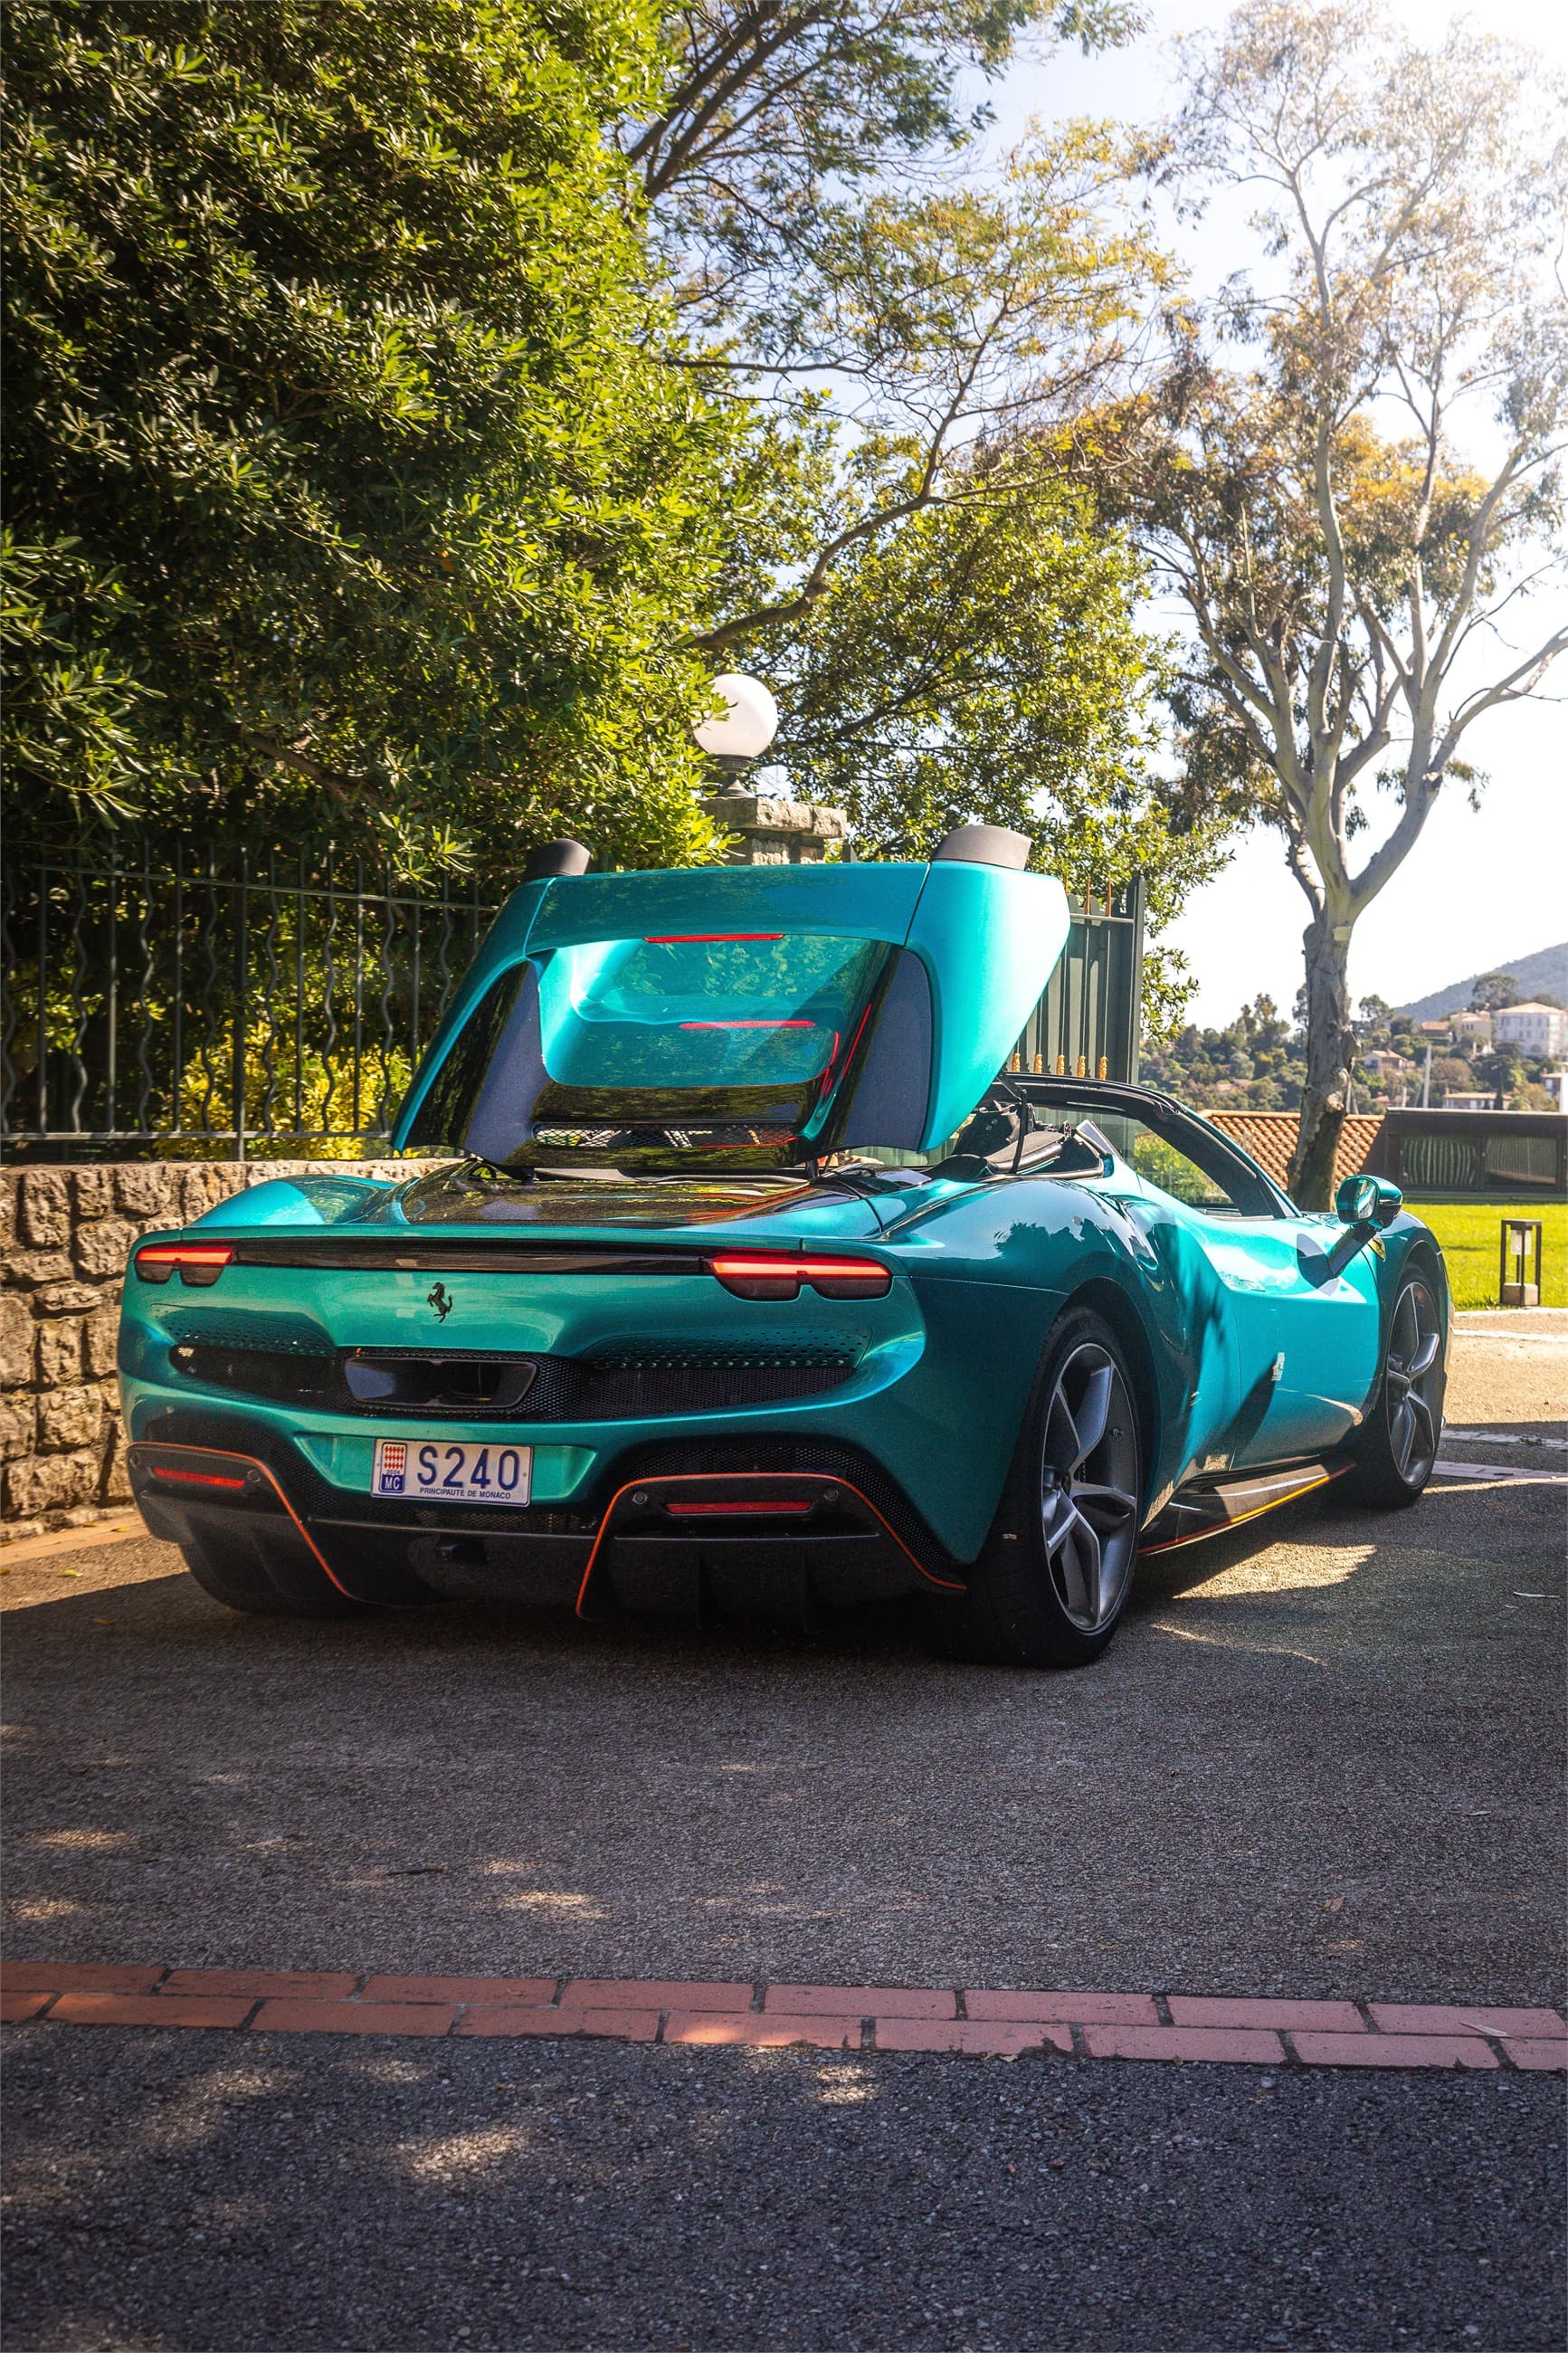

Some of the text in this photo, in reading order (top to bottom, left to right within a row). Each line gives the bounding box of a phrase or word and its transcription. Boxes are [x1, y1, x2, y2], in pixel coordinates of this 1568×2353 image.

[417, 1445, 519, 1491] S240
[384, 1476, 400, 1490] MC
[480, 1491, 511, 1500] MONACO
